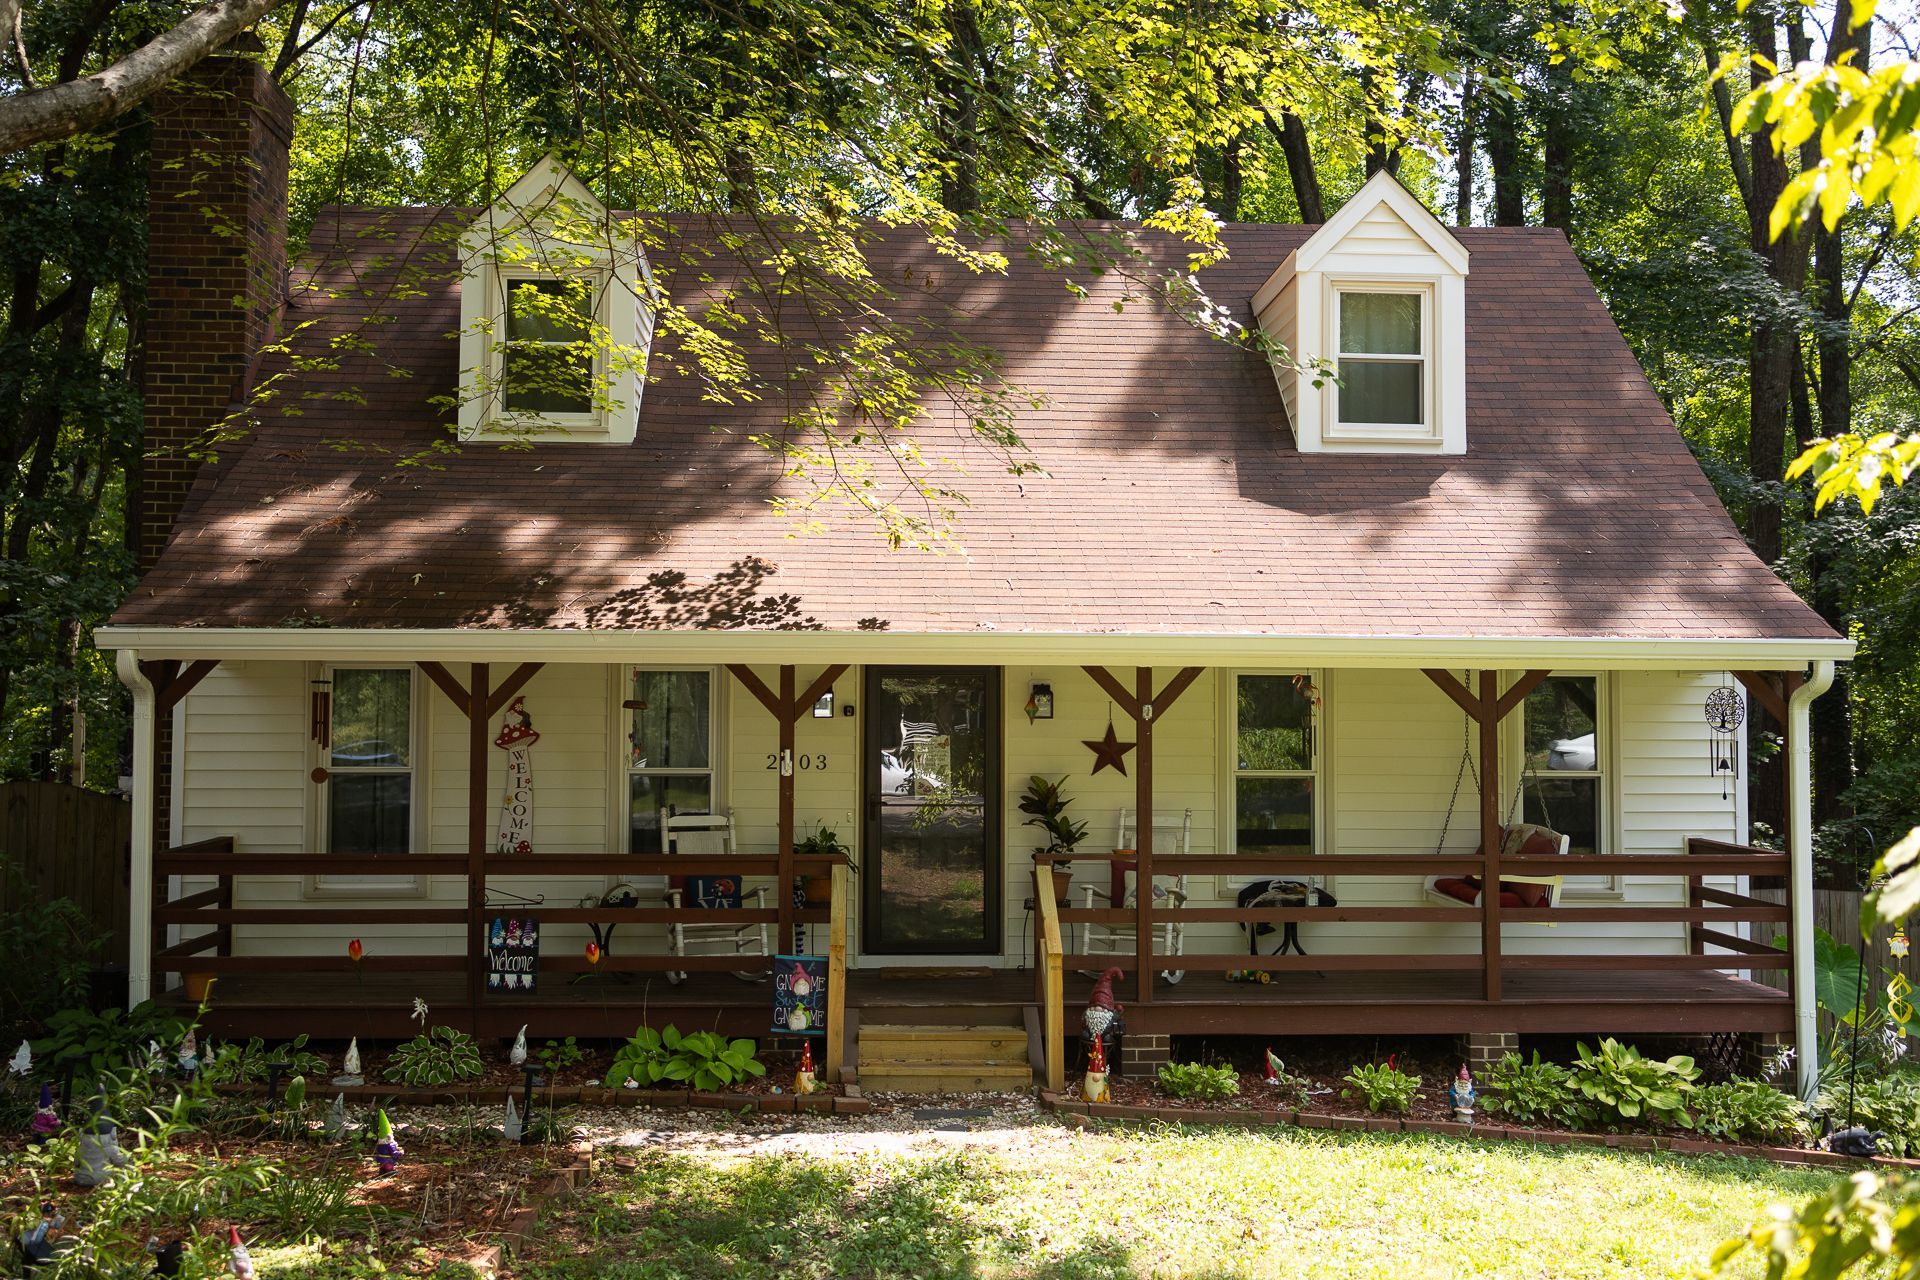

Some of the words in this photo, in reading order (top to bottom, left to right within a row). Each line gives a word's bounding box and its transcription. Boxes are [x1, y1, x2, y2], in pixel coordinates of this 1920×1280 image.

[766, 754, 827, 770] 203
[510, 749, 527, 844] WELCOME
[489, 948, 534, 971] Welcome
[776, 974, 826, 992] GNME
[775, 991, 824, 1009] Swet
[774, 1007, 825, 1027] GNME
